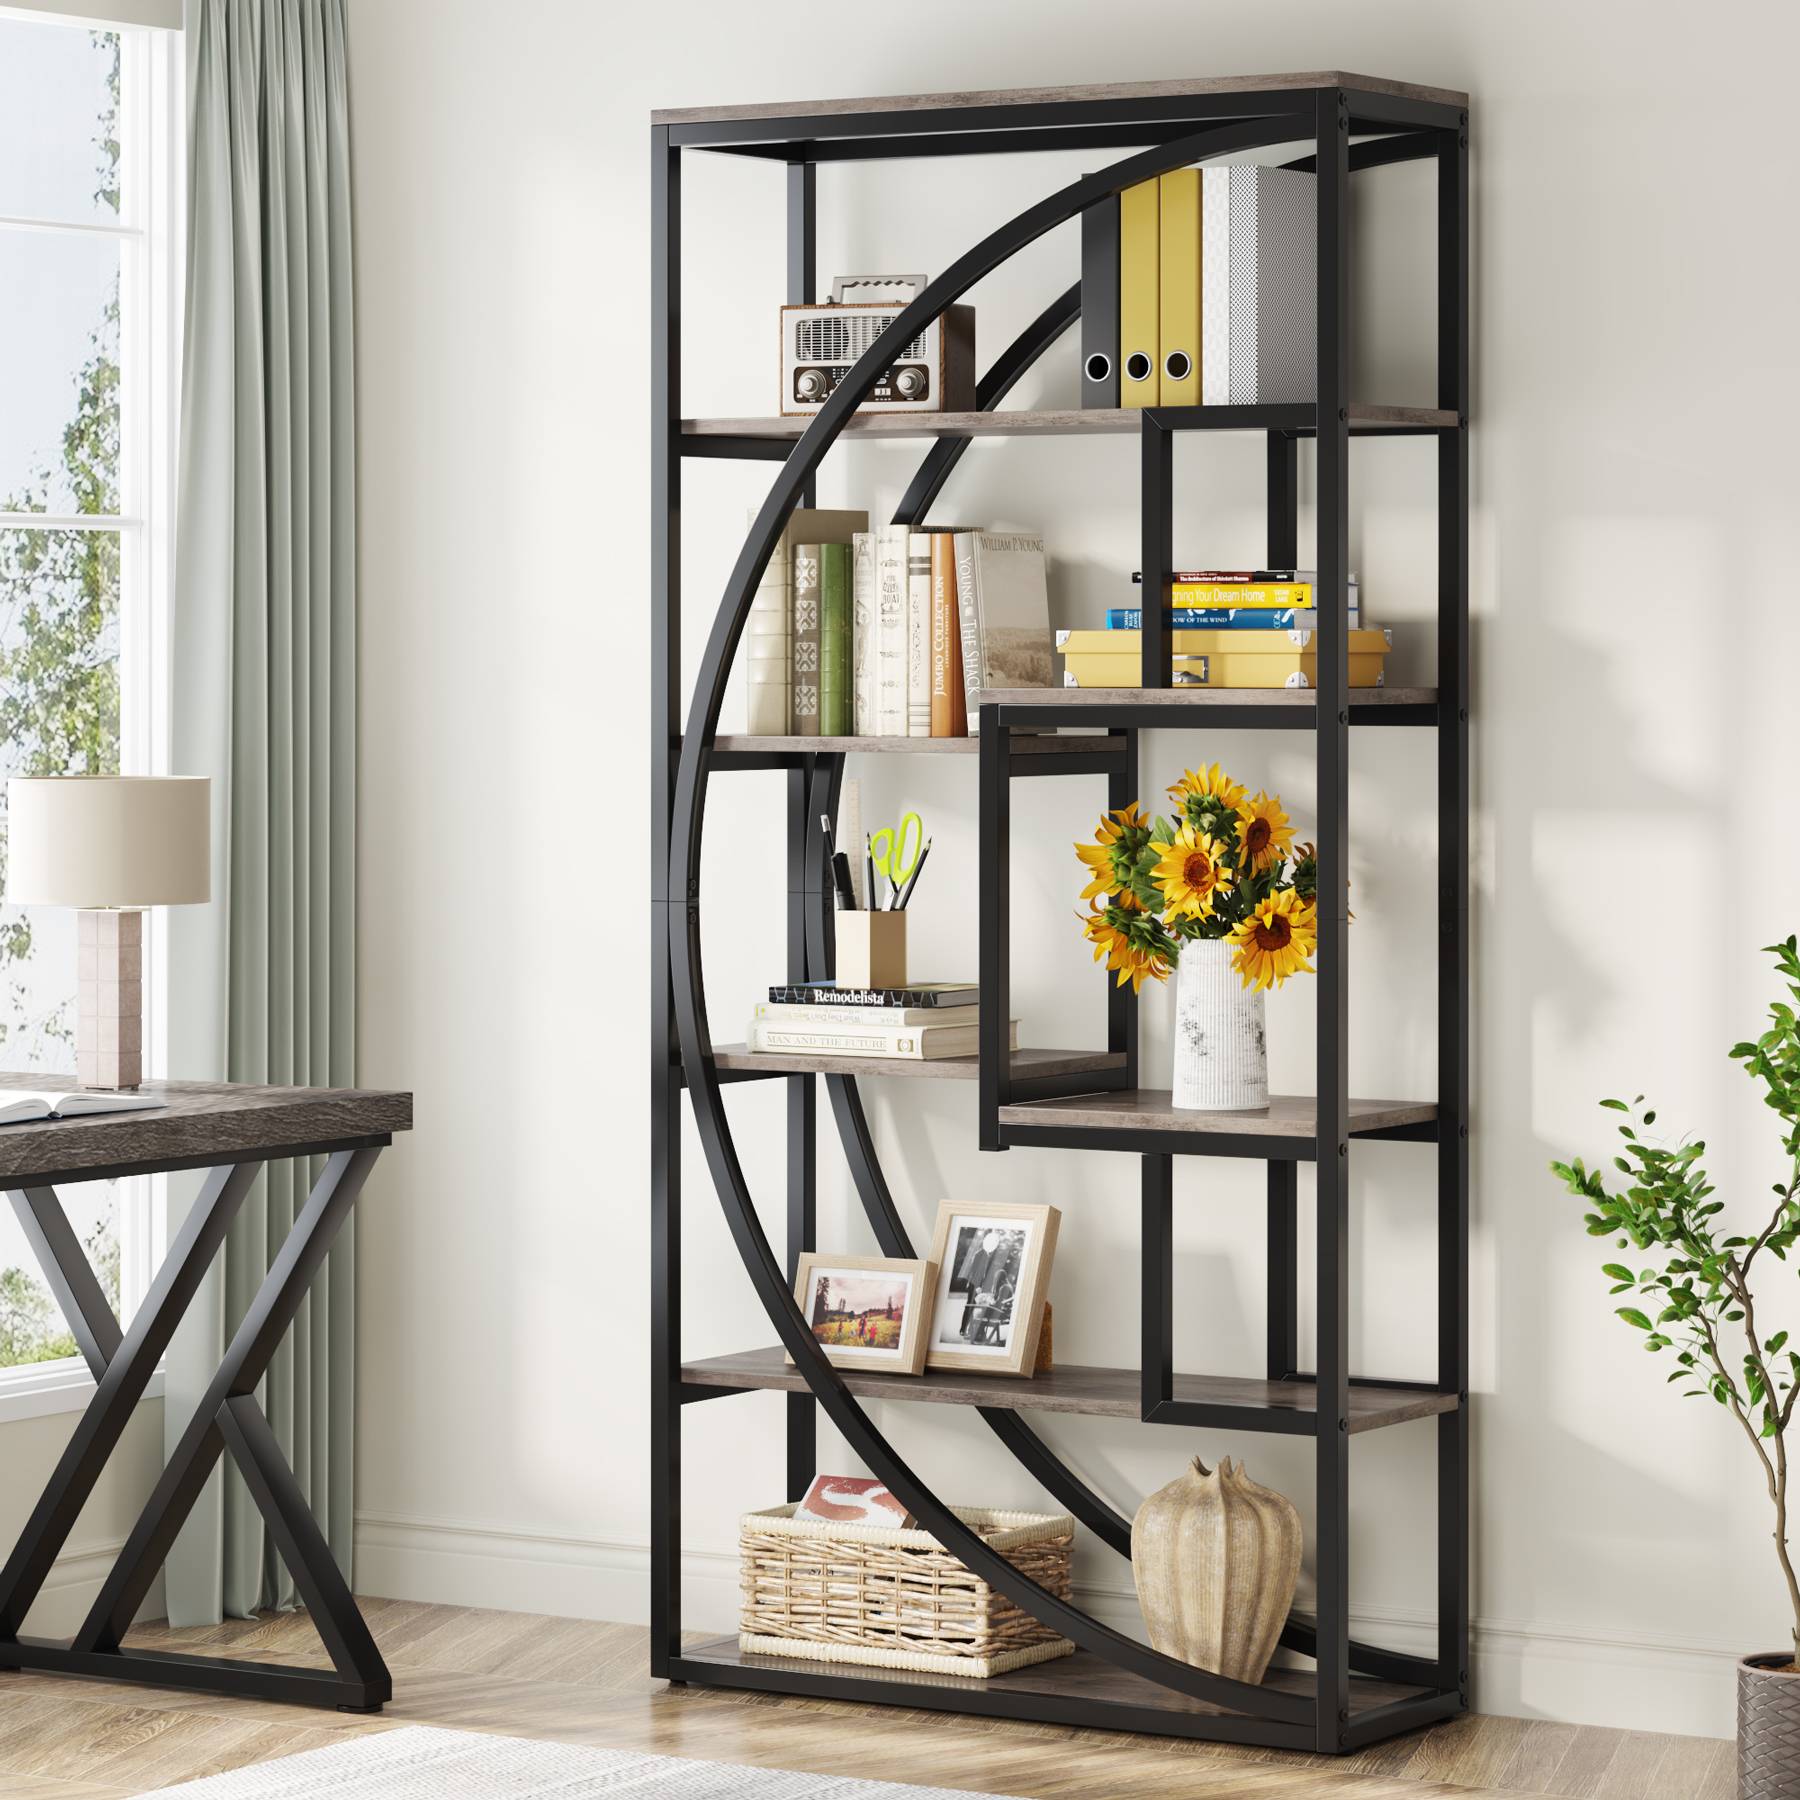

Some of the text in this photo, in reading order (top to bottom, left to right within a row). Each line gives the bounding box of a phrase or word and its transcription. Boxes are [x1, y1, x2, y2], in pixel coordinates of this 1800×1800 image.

[980, 536, 1011, 551] WILLIAM
[1018, 537, 1044, 552] YOUNG
[1172, 591, 1195, 606] gning
[1195, 588, 1212, 602] Your
[1213, 588, 1241, 602] Dream
[1242, 588, 1265, 602] Home
[960, 556, 980, 695] YOUNG THE SHACK
[934, 576, 948, 696] JUMBO COLLECTION
[814, 989, 885, 1005] Remodelista
[768, 1035, 791, 1044] MAN
[793, 1036, 817, 1045] AND
[820, 1038, 841, 1046] THE
[844, 1039, 887, 1049] FUTURE
